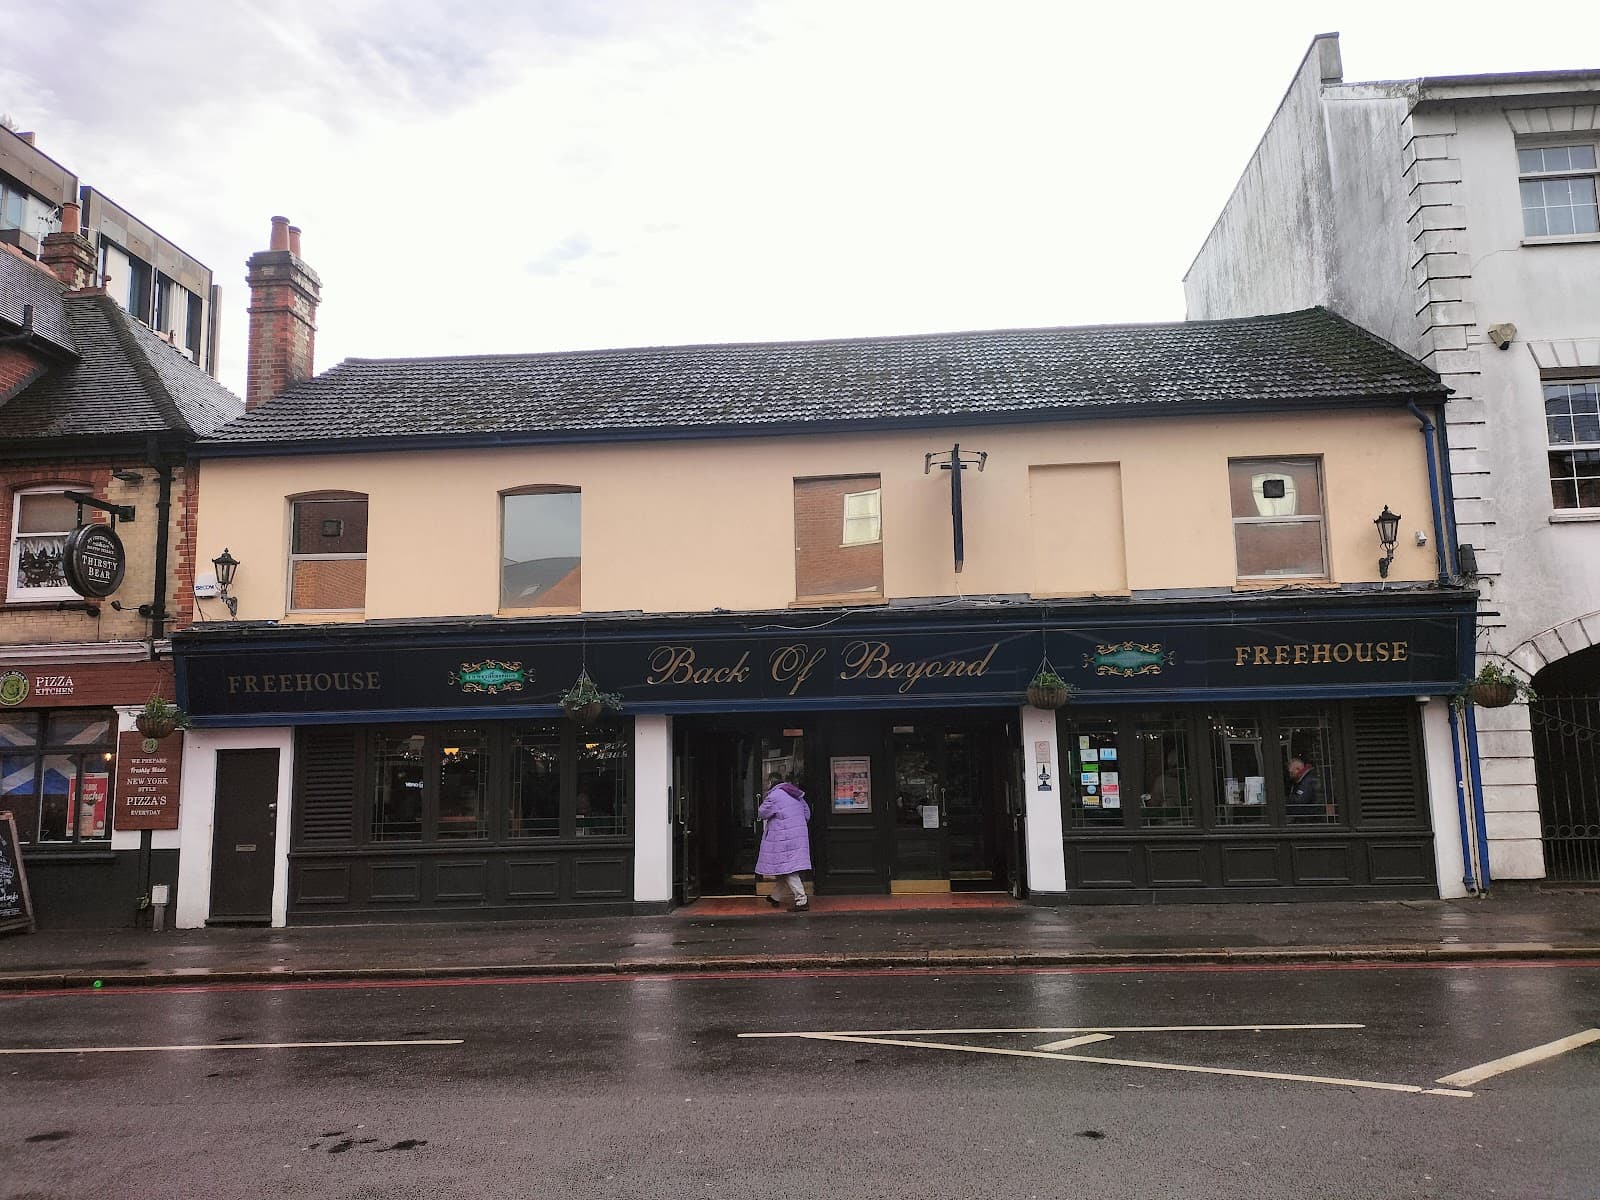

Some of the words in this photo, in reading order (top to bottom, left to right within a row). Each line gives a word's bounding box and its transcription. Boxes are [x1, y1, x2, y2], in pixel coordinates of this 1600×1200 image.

[82, 555, 118, 571] THIRSTY
[88, 566, 110, 580] BEAR
[1234, 640, 1408, 666] FREEHOUSE
[647, 645, 751, 685] Back
[768, 643, 827, 695] Of
[840, 640, 999, 694] Beyond
[35, 675, 74, 687] PIZZA
[227, 671, 381, 694] FREEHOUSE
[35, 687, 74, 696] KITCHEN
[147, 777, 169, 785] YORK
[127, 795, 167, 806] PIZZA'S
